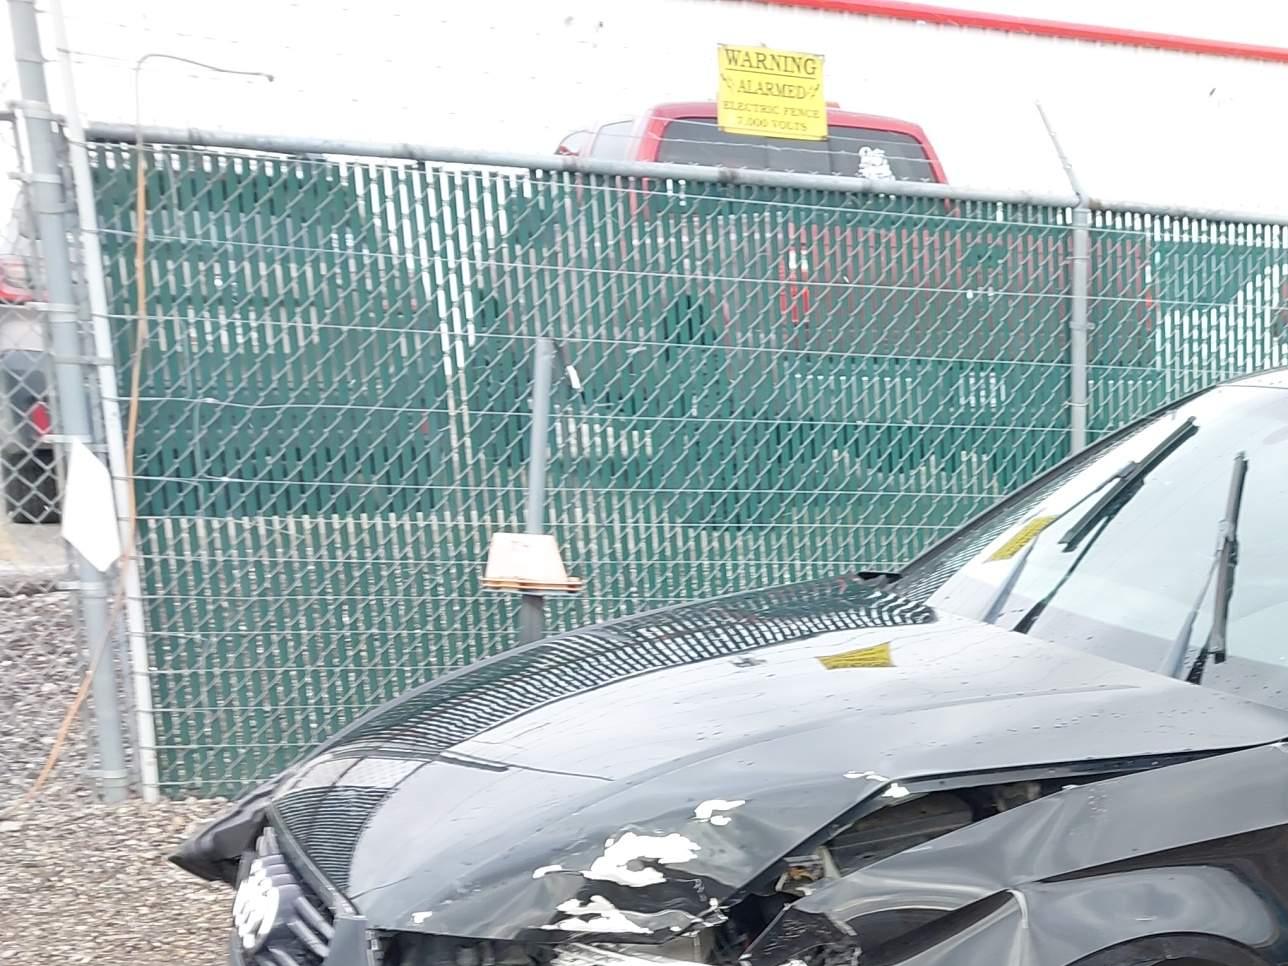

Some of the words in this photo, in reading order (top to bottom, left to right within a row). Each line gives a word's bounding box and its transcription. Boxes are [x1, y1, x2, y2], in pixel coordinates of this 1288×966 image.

[724, 49, 817, 75] WARNING
[738, 79, 807, 99] ALARMED
[722, 101, 780, 114] ELECTRIC
[783, 107, 821, 119] FENCE
[771, 119, 809, 131] VOLTS
